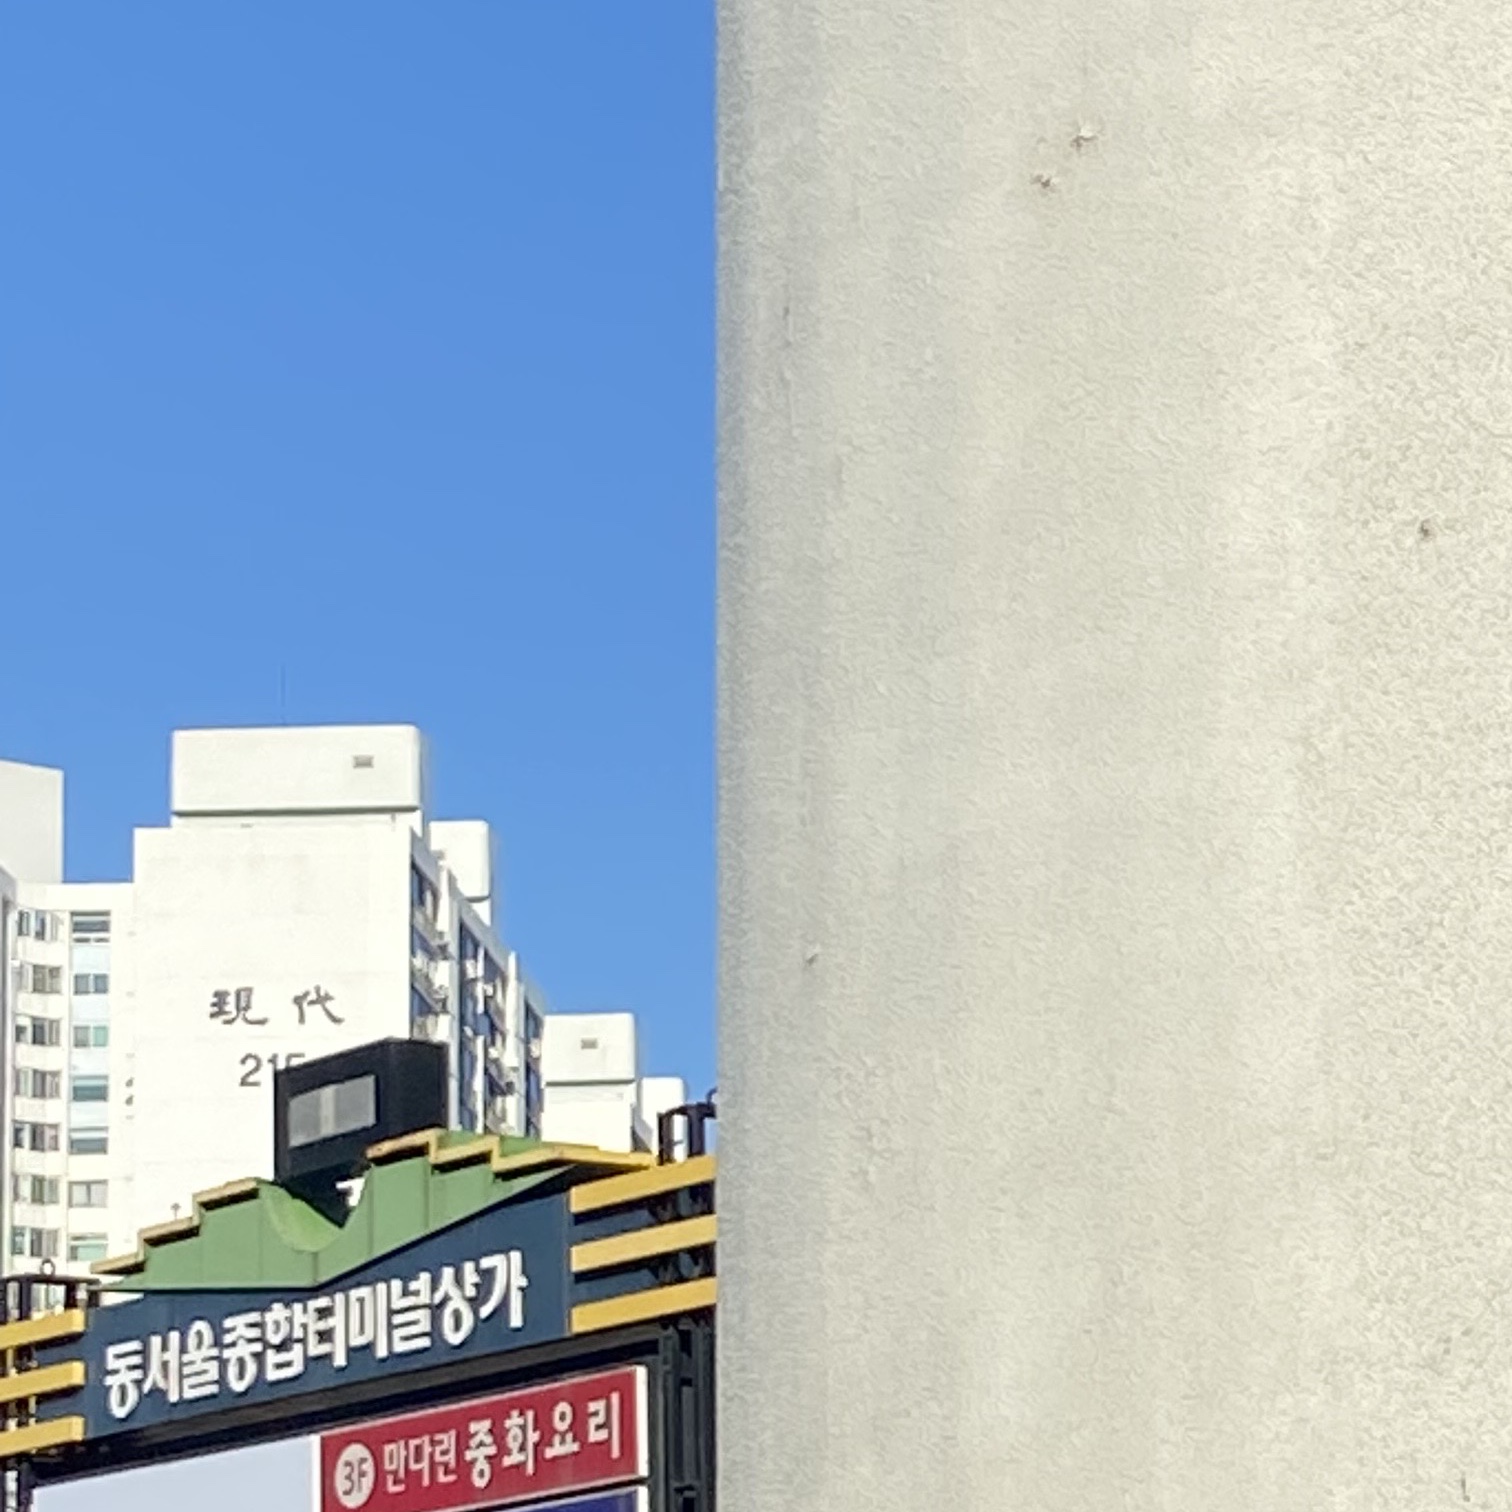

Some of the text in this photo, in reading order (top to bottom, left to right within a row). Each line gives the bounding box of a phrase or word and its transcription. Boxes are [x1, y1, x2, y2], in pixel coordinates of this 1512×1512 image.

[208, 984, 345, 1026] 現代
[103, 1250, 528, 1419] 동서울종합터미널상가
[341, 1390, 622, 1498] 3F 만다린 중화요리
